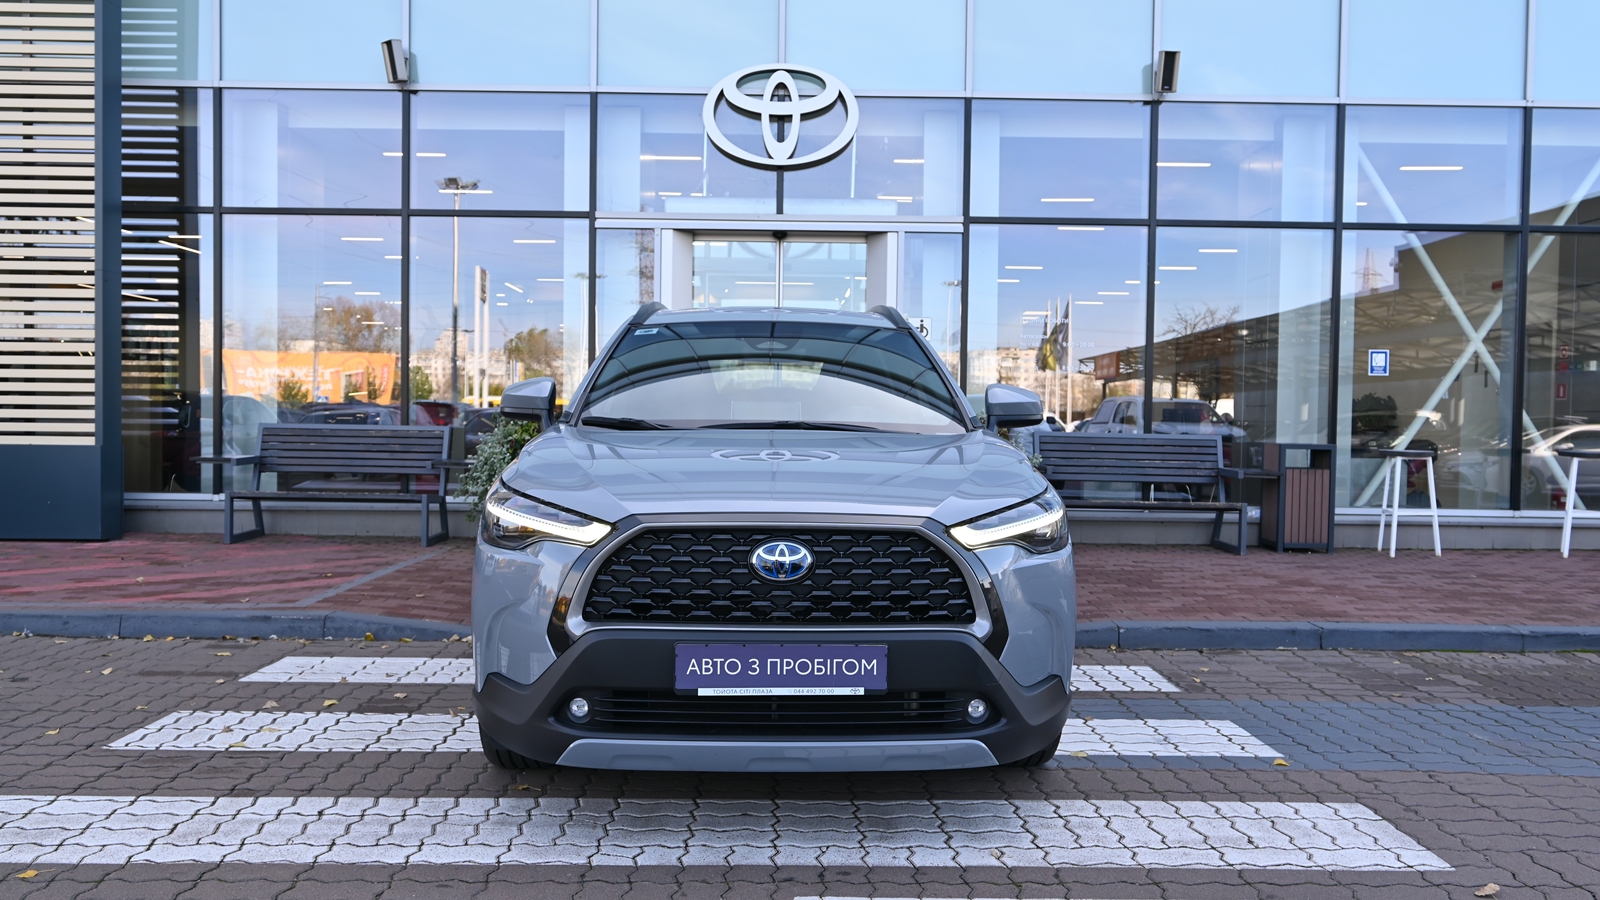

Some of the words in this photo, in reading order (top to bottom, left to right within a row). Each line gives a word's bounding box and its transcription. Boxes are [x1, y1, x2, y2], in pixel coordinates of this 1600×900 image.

[687, 658, 741, 676] АВТО
[748, 658, 760, 676] З
[767, 658, 878, 676] ПРОБІГОМ
